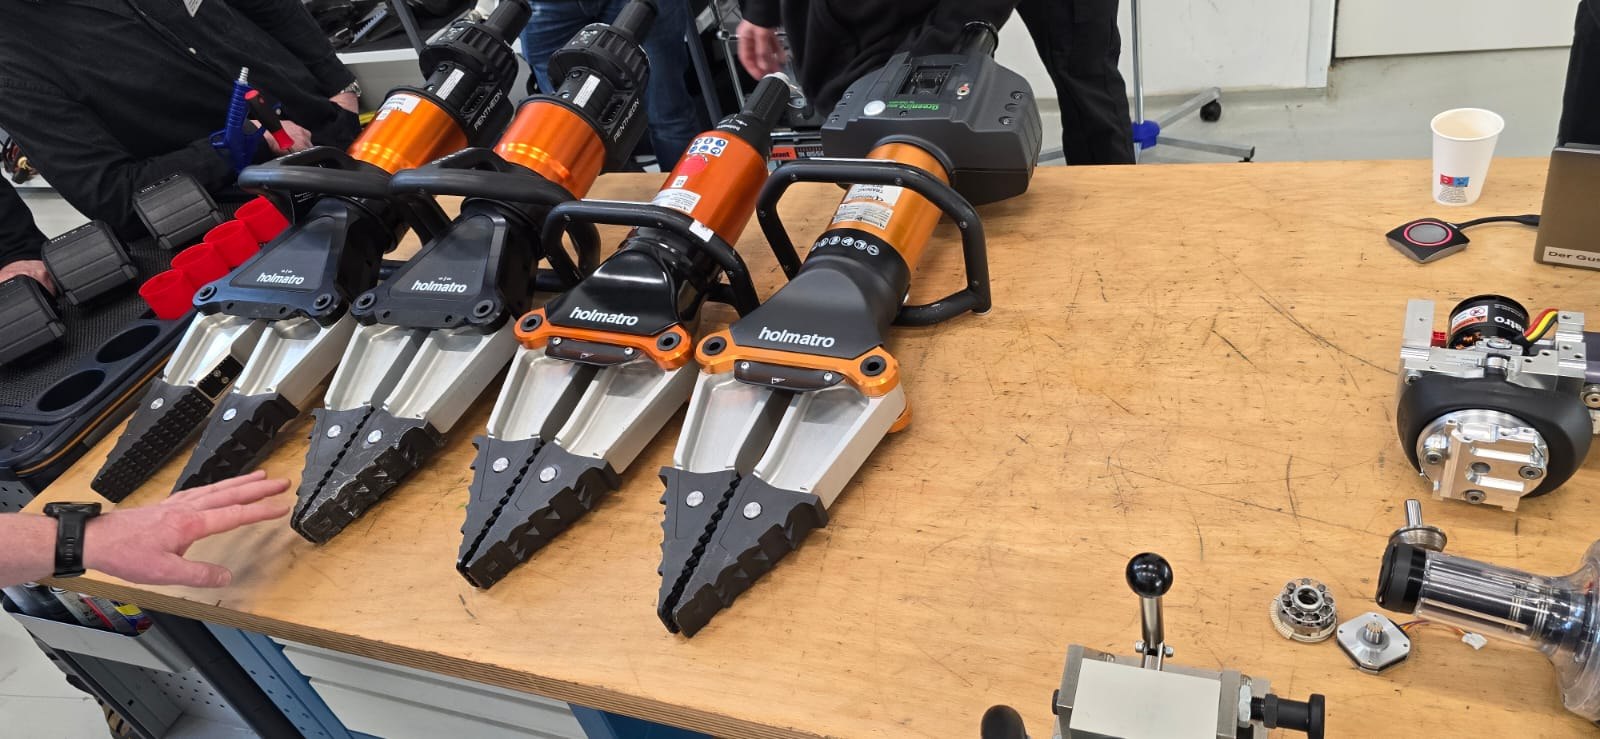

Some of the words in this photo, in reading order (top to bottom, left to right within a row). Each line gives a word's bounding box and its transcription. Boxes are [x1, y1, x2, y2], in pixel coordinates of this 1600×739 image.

[473, 89, 504, 131] PENTHEON
[613, 98, 641, 144] PENTHEON
[1548, 251, 1573, 259] Der
[256, 272, 305, 286] holmatro
[411, 279, 467, 294] holmatro
[569, 306, 639, 326] holmatro
[758, 326, 835, 349] holmatro
